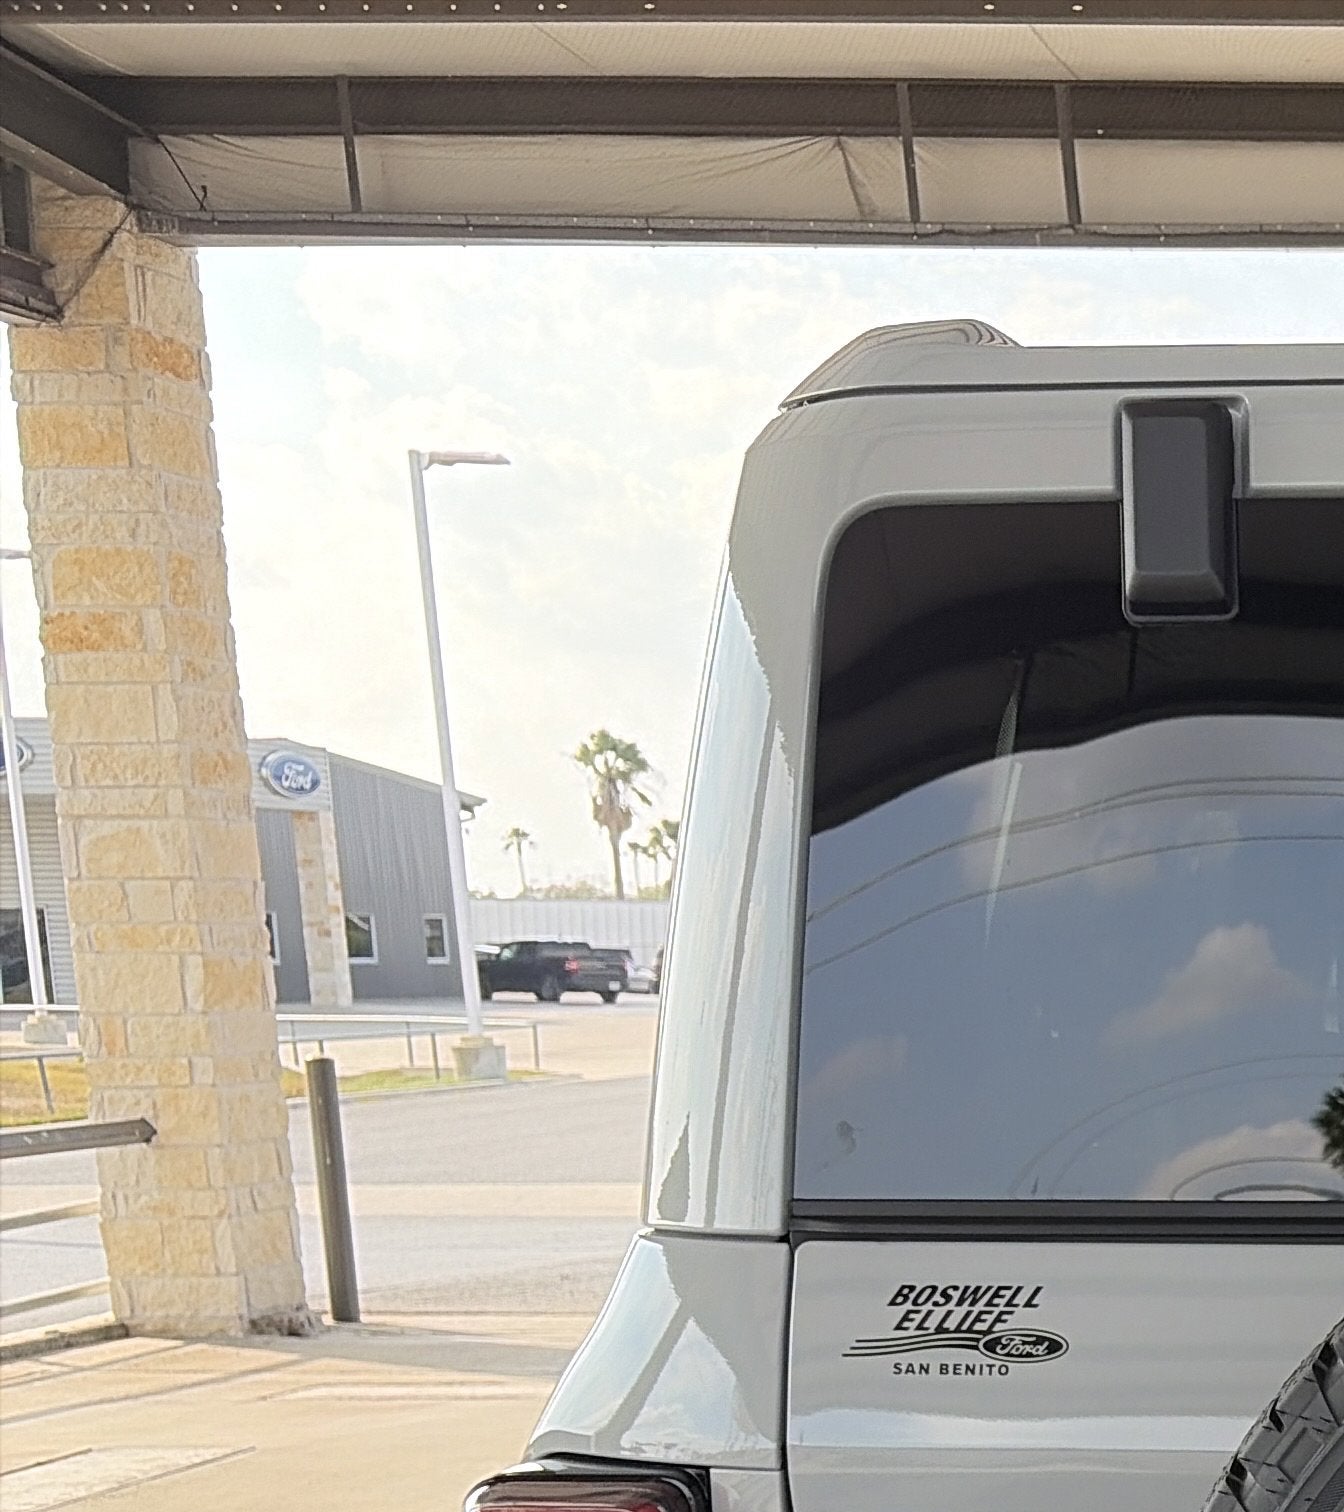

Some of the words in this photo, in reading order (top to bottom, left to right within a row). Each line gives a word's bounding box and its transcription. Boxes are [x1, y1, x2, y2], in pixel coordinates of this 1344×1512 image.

[281, 761, 313, 790] Ford
[887, 1284, 1044, 1309] BOSWELL
[893, 1309, 1016, 1332] ELLIFF
[997, 1336, 1049, 1356] Ford
[893, 1362, 930, 1375] SAN
[939, 1363, 1009, 1376] BENITO
